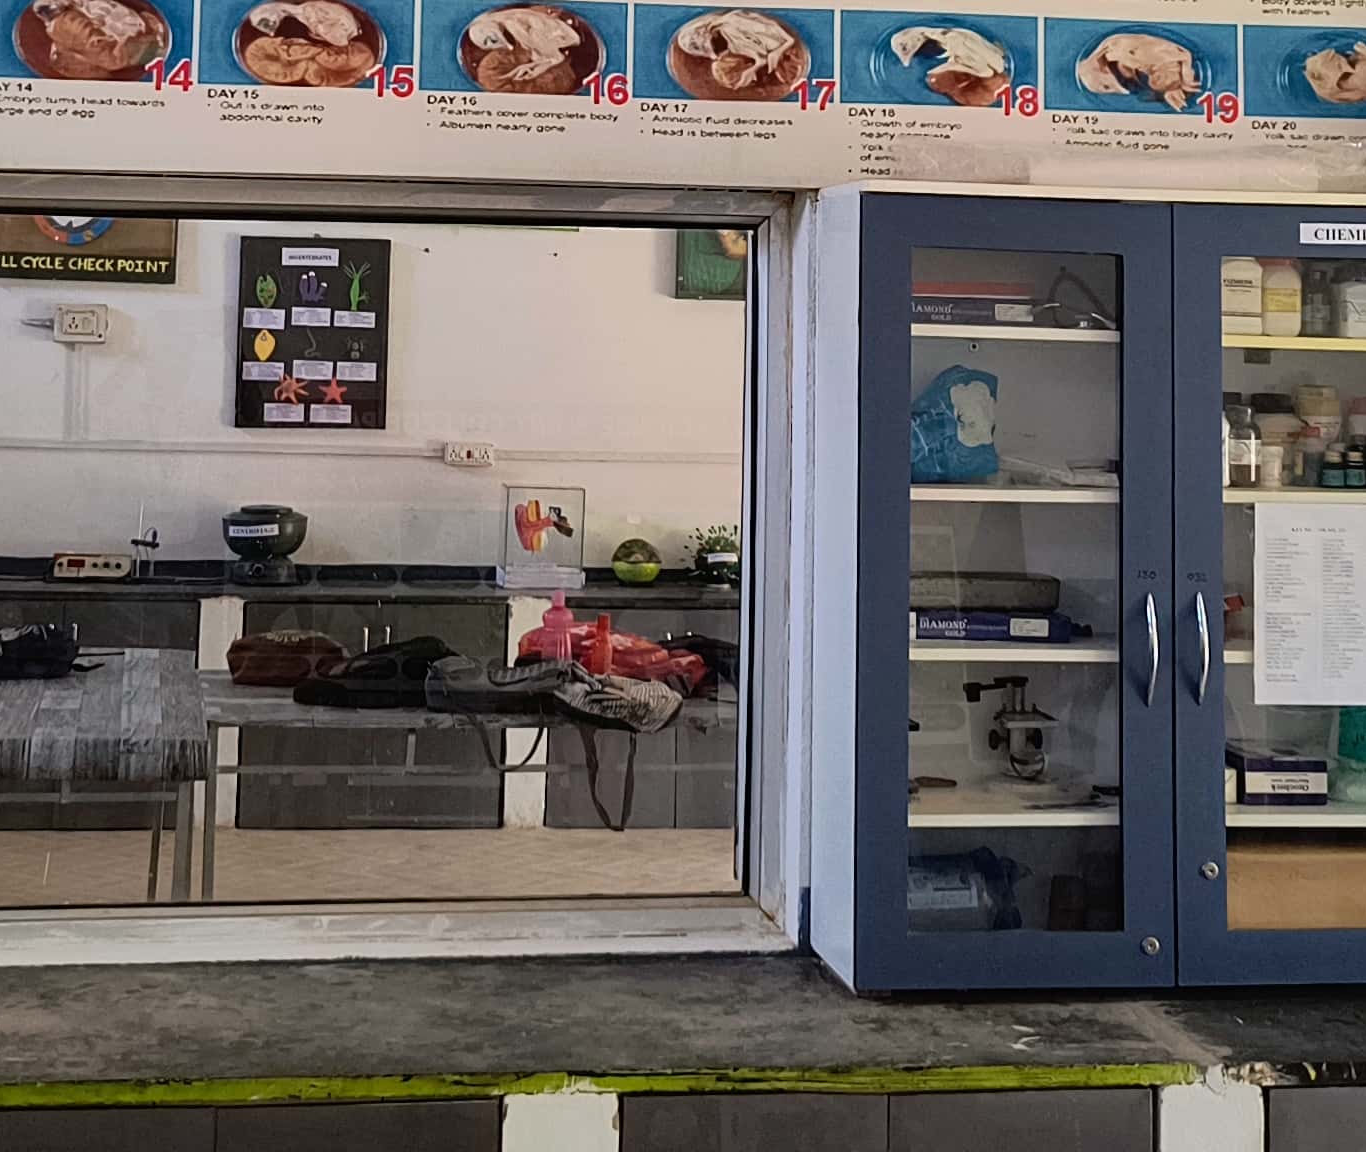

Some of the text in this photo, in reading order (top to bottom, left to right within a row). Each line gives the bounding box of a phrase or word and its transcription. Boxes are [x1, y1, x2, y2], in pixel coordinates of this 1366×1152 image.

[145, 58, 194, 93] 14
[365, 65, 416, 98] 15
[15, 82, 33, 92] 14
[583, 72, 631, 106] 16
[208, 89, 259, 99] DAY 15
[791, 79, 836, 112] 17
[428, 95, 477, 106] DAY 16
[995, 85, 1040, 118] 18
[640, 102, 688, 113] DAY 17
[849, 108, 895, 117] DAY 18
[1197, 92, 1240, 124] 19
[1052, 114, 1098, 124] DAY 19
[1252, 120, 1296, 130] DAY 20
[21, 256, 64, 270] CYCLE
[69, 257, 114, 271] CHECK
[117, 260, 170, 273] POINT
[920, 617, 966, 629] DIAMOND
